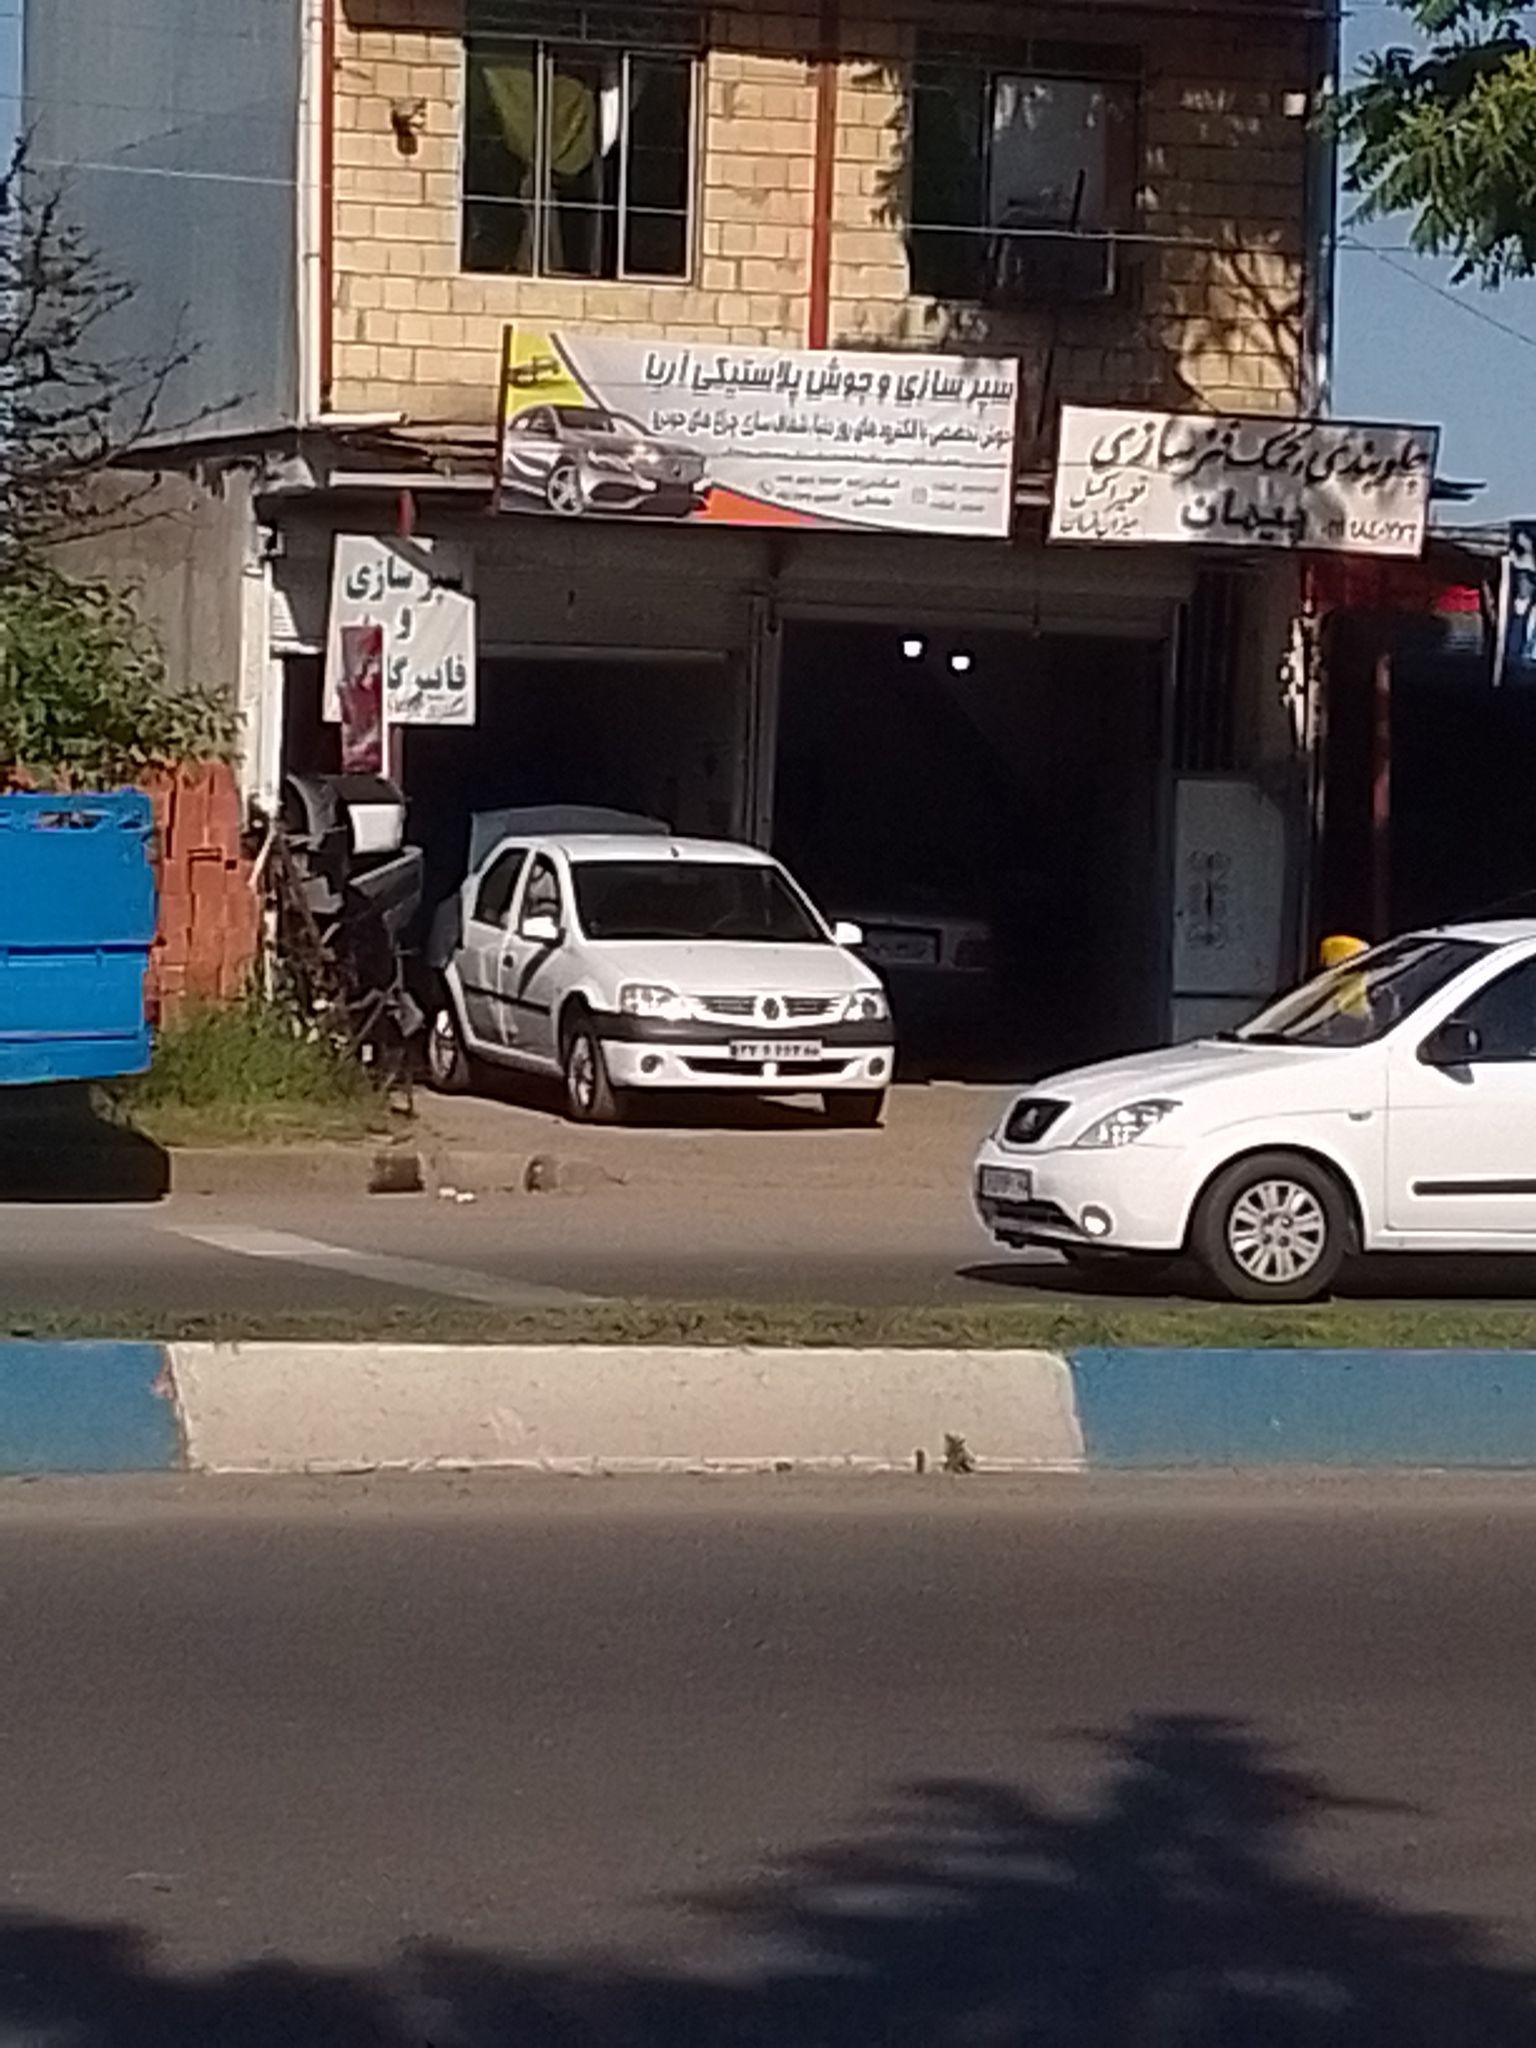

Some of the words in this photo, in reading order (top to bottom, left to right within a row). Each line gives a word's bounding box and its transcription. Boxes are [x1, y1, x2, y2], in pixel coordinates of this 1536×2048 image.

[692, 356, 802, 408] پلاستیکی
[806, 356, 873, 407] جوش
[878, 373, 892, 404] و
[894, 369, 963, 407] سازی
[966, 377, 1014, 417] سپر
[1181, 486, 1309, 547] پیمان
[347, 555, 414, 600] سازی
[395, 607, 412, 640] و
